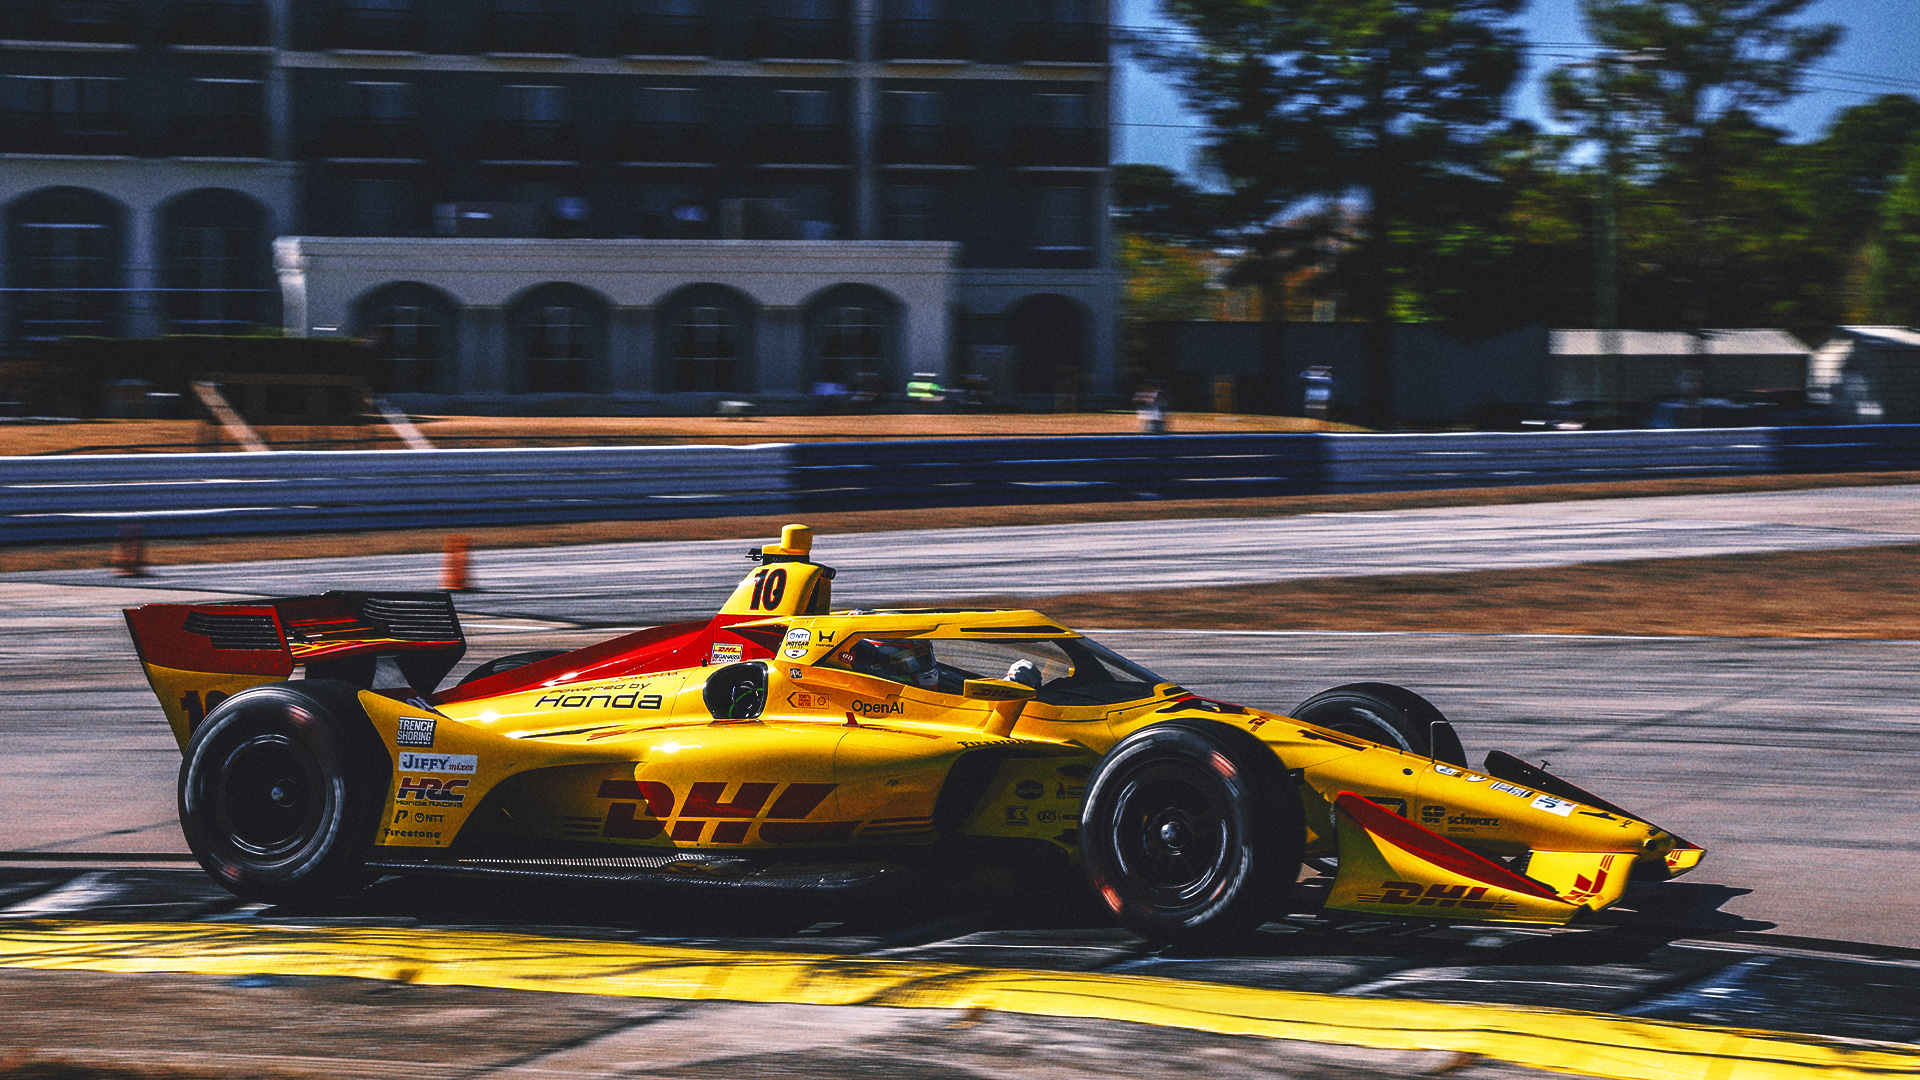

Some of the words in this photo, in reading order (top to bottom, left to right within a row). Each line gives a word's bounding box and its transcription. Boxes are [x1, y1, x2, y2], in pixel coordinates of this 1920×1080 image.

[750, 568, 787, 611] 10
[629, 682, 651, 691] by
[979, 687, 1015, 698] DHL
[534, 691, 663, 710] Honda
[851, 700, 904, 715] OpenAI
[399, 719, 434, 732] TRENCH
[397, 730, 432, 742] SHORING
[448, 763, 474, 772] mixes
[396, 776, 471, 802] HRC
[425, 814, 444, 823] NTT
[596, 779, 864, 845] DHL
[1447, 813, 1500, 827] schwarz
[383, 828, 442, 839] Firestone
[1378, 881, 1496, 911] DHL
